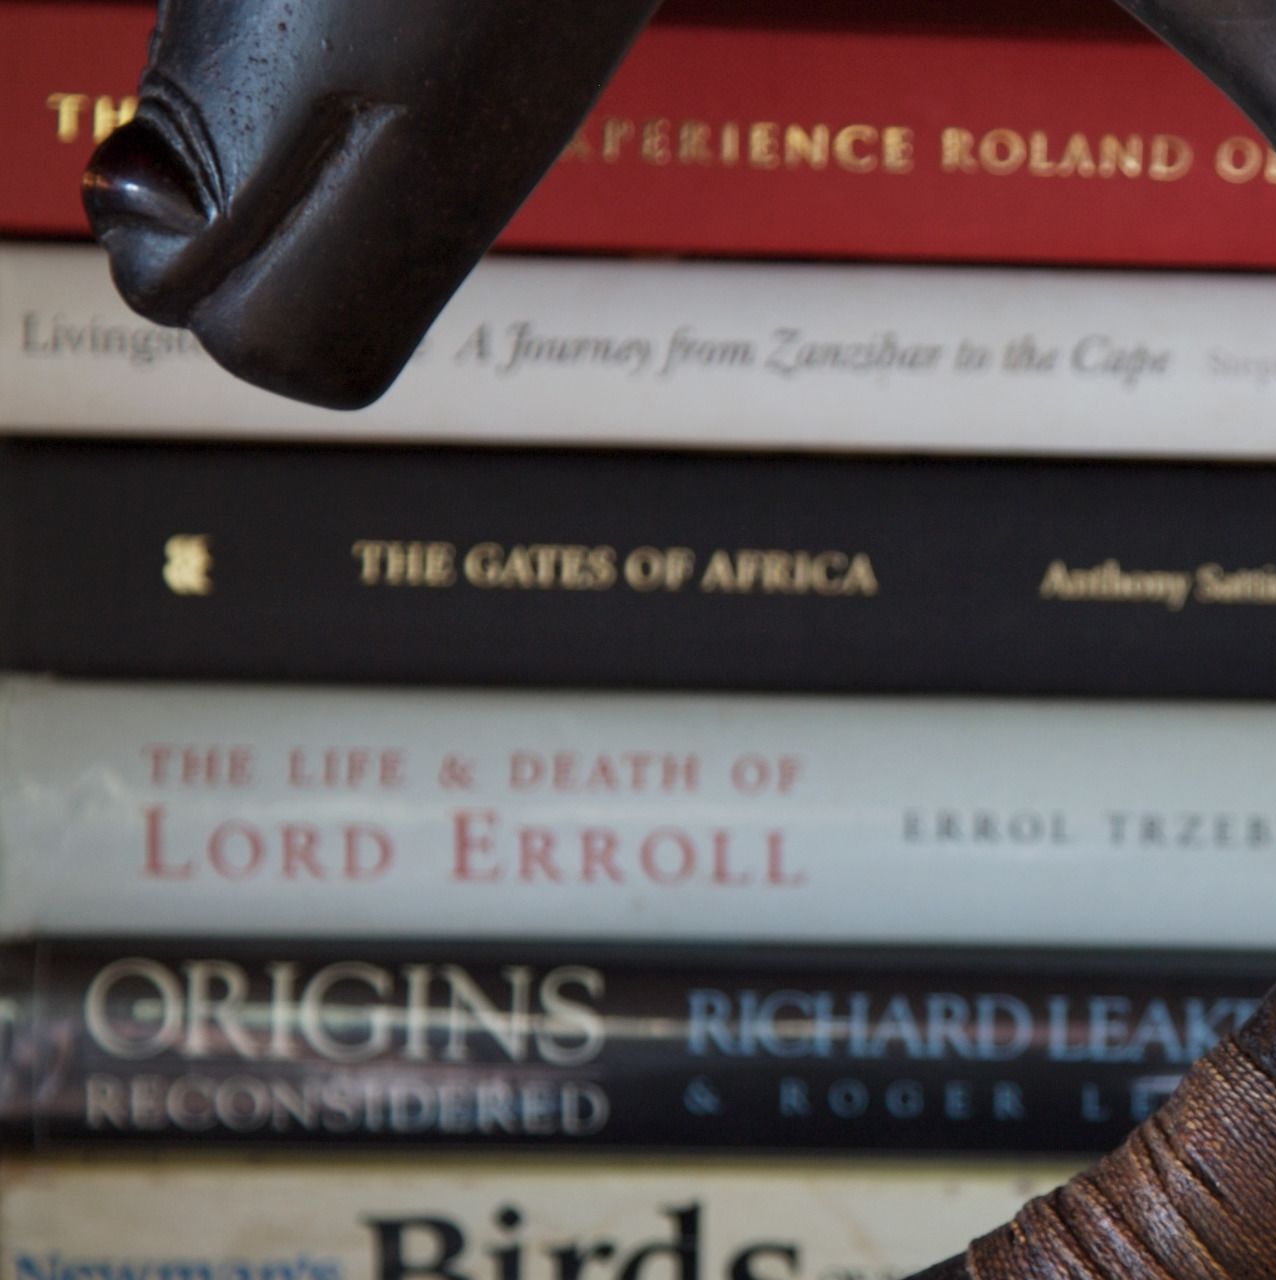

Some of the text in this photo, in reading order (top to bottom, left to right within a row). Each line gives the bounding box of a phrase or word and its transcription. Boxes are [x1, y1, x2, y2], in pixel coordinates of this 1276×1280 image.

[46, 92, 139, 144] TH
[941, 125, 1193, 182] ROLAND
[497, 321, 652, 380] Journey
[655, 324, 756, 379] from
[764, 327, 942, 380] Zanzibar
[953, 336, 991, 372] to
[1003, 331, 1057, 373] the
[1070, 332, 1173, 391] Cape
[352, 540, 880, 597] THE GATES OF AFRICA
[144, 743, 808, 796] THE LIFE & DEATH OF
[902, 808, 1073, 848] ERROL
[84, 957, 606, 1067] ORIGINS
[686, 987, 1036, 1061] RICHARD
[85, 1073, 611, 1137] RECONSIDERED
[779, 1076, 1028, 1121] ROGER
